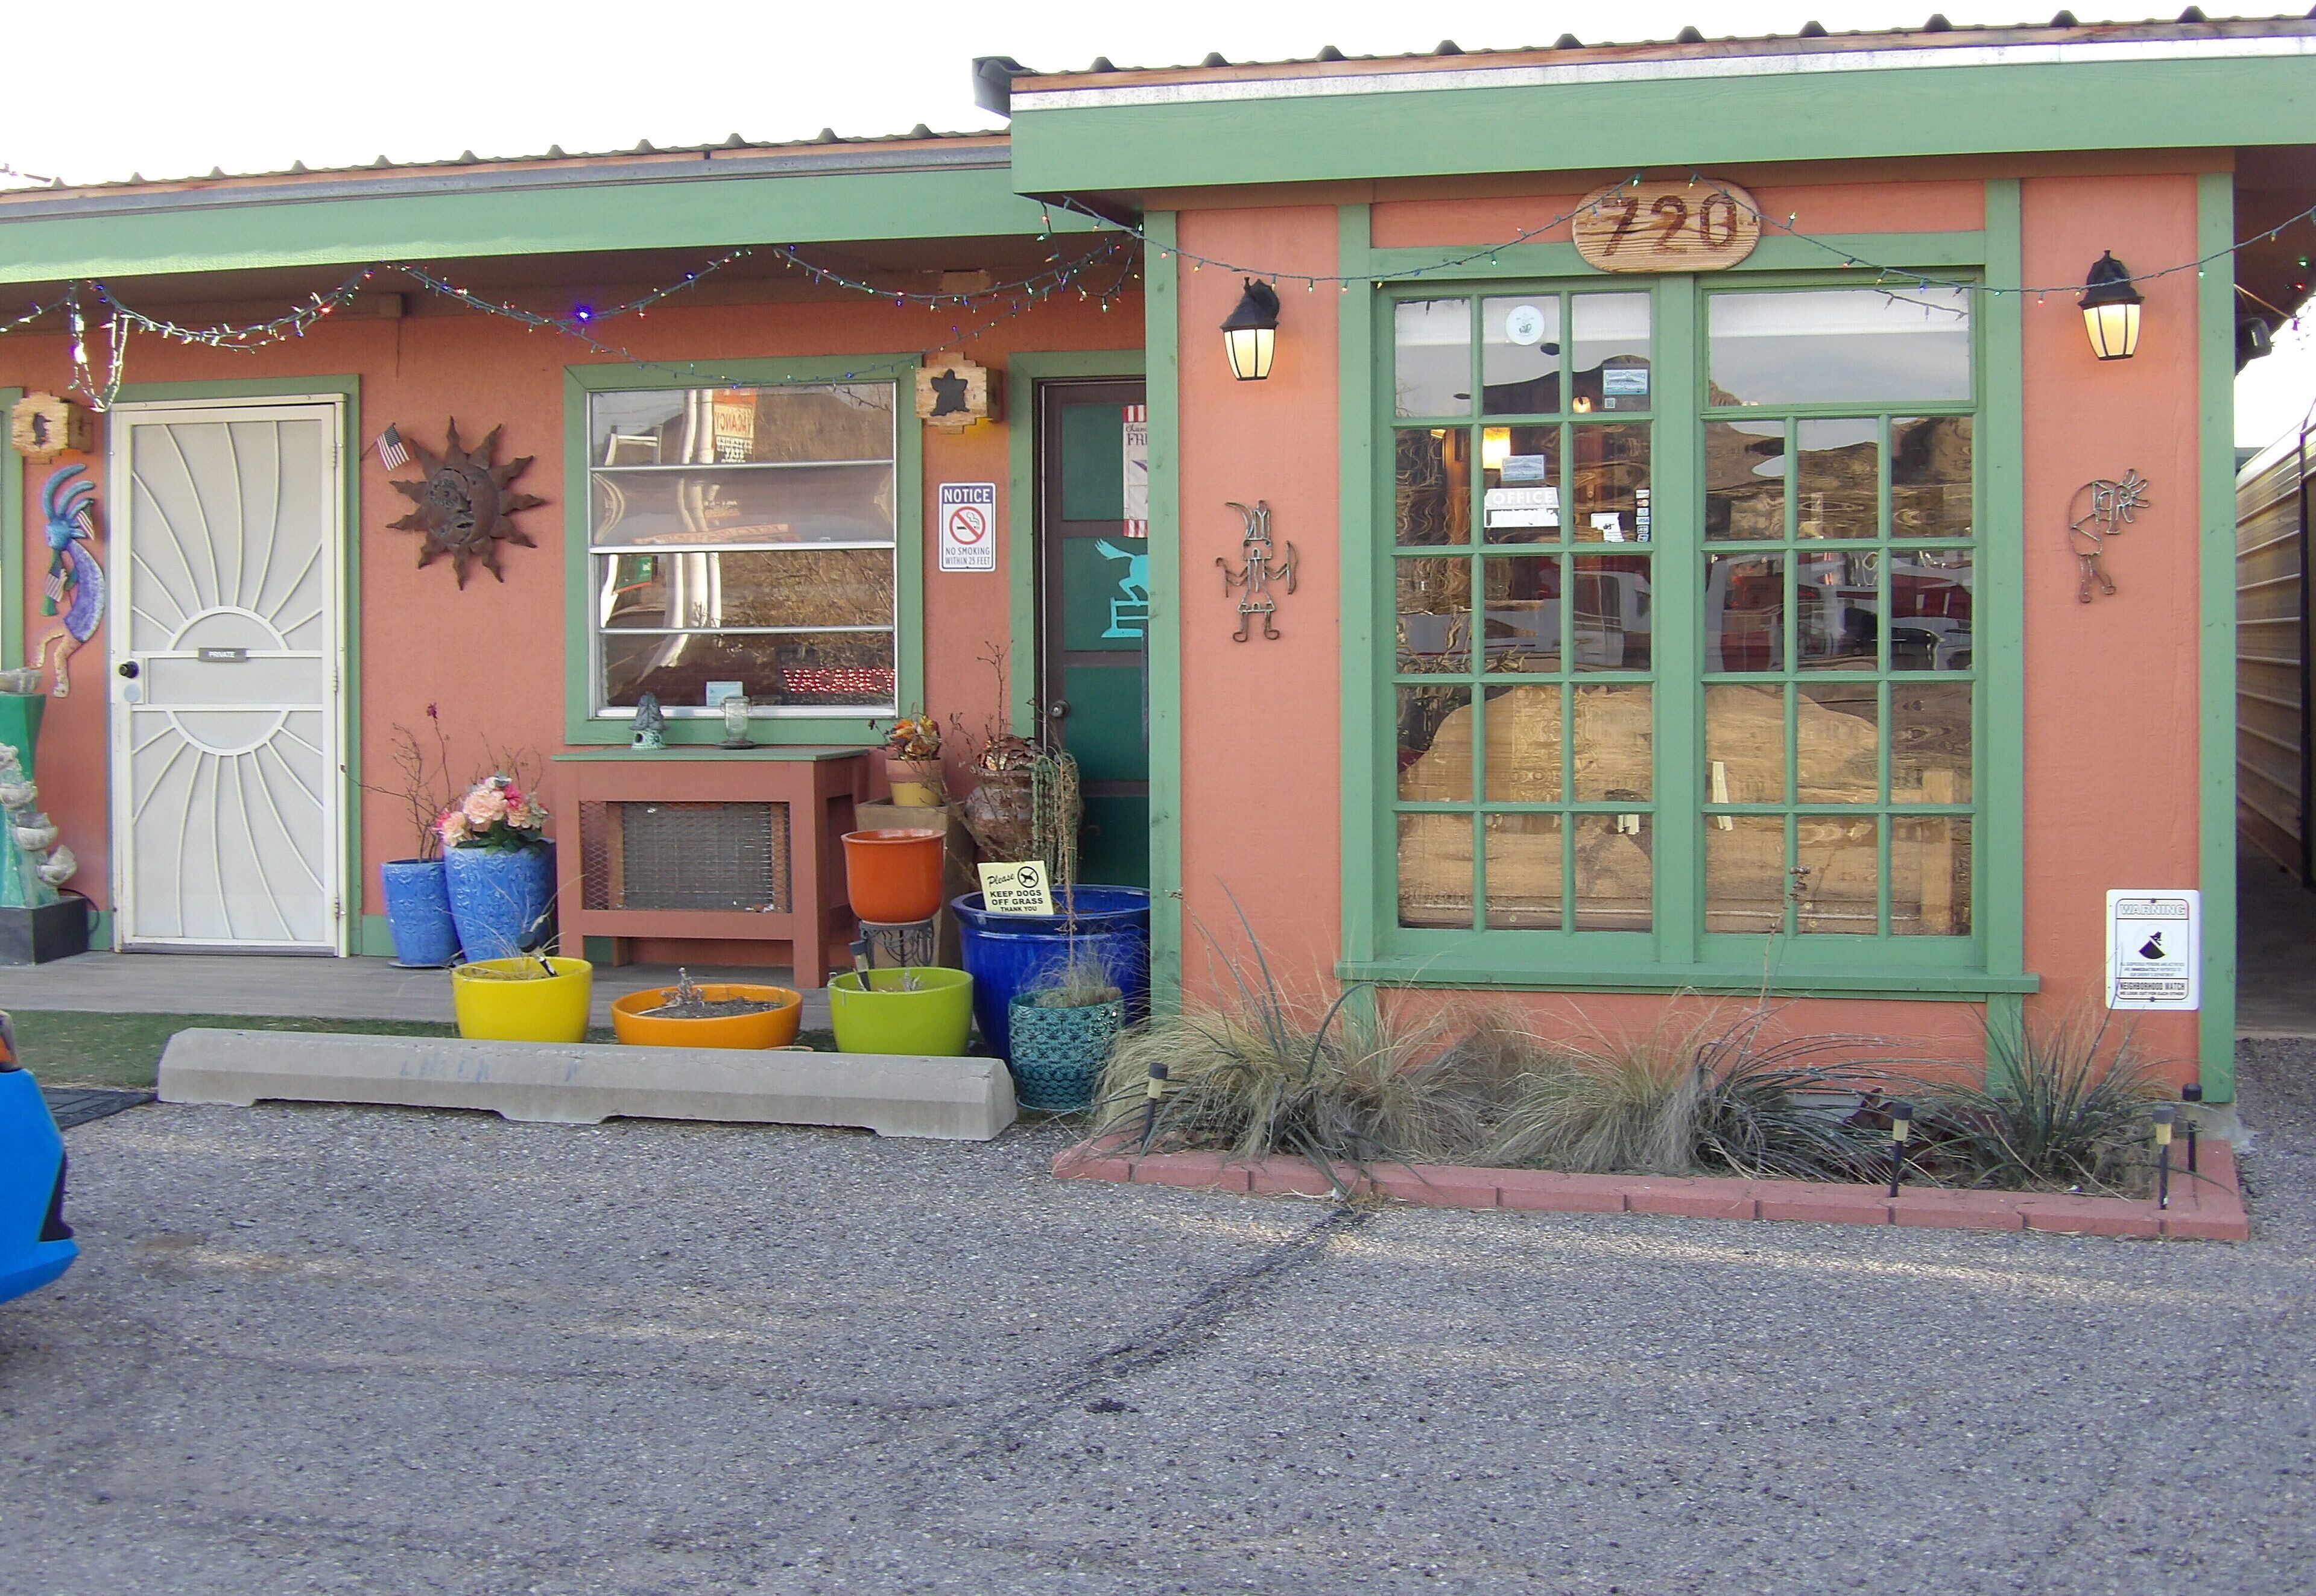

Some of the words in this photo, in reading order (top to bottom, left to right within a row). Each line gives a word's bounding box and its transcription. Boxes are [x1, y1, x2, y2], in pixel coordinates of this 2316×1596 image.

[1602, 194, 1737, 256] 720
[944, 489, 990, 503] NOTICE
[1492, 491, 1552, 505] OFFICE
[782, 669, 895, 692] VACANCY
[987, 873, 1015, 888] Please
[2120, 904, 2185, 915] WARNING
